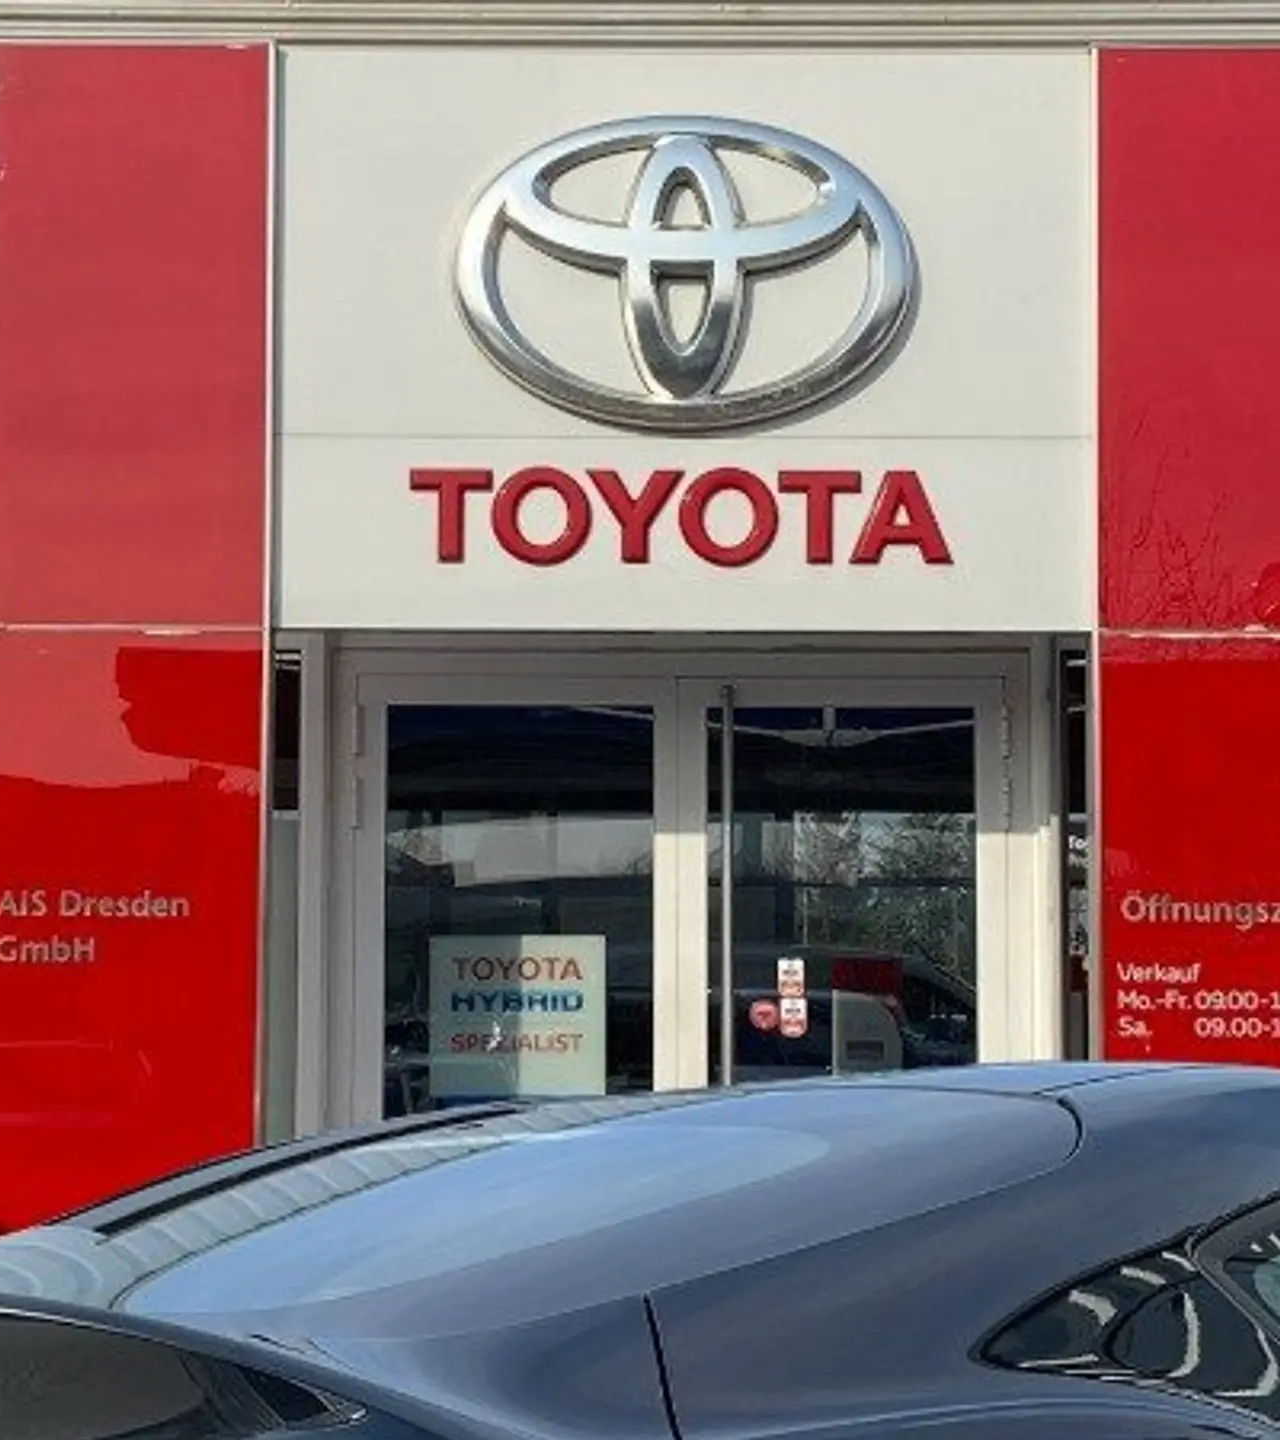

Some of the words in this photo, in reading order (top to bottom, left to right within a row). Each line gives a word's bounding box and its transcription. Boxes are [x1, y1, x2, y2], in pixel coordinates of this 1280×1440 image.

[408, 466, 955, 568] TOYOTA
[58, 888, 191, 918] Dresden
[451, 956, 583, 981] TOYOTA
[1117, 963, 1201, 982] Verkauf
[451, 991, 584, 1012] HYBRID
[1118, 1017, 1153, 1037] Sa.
